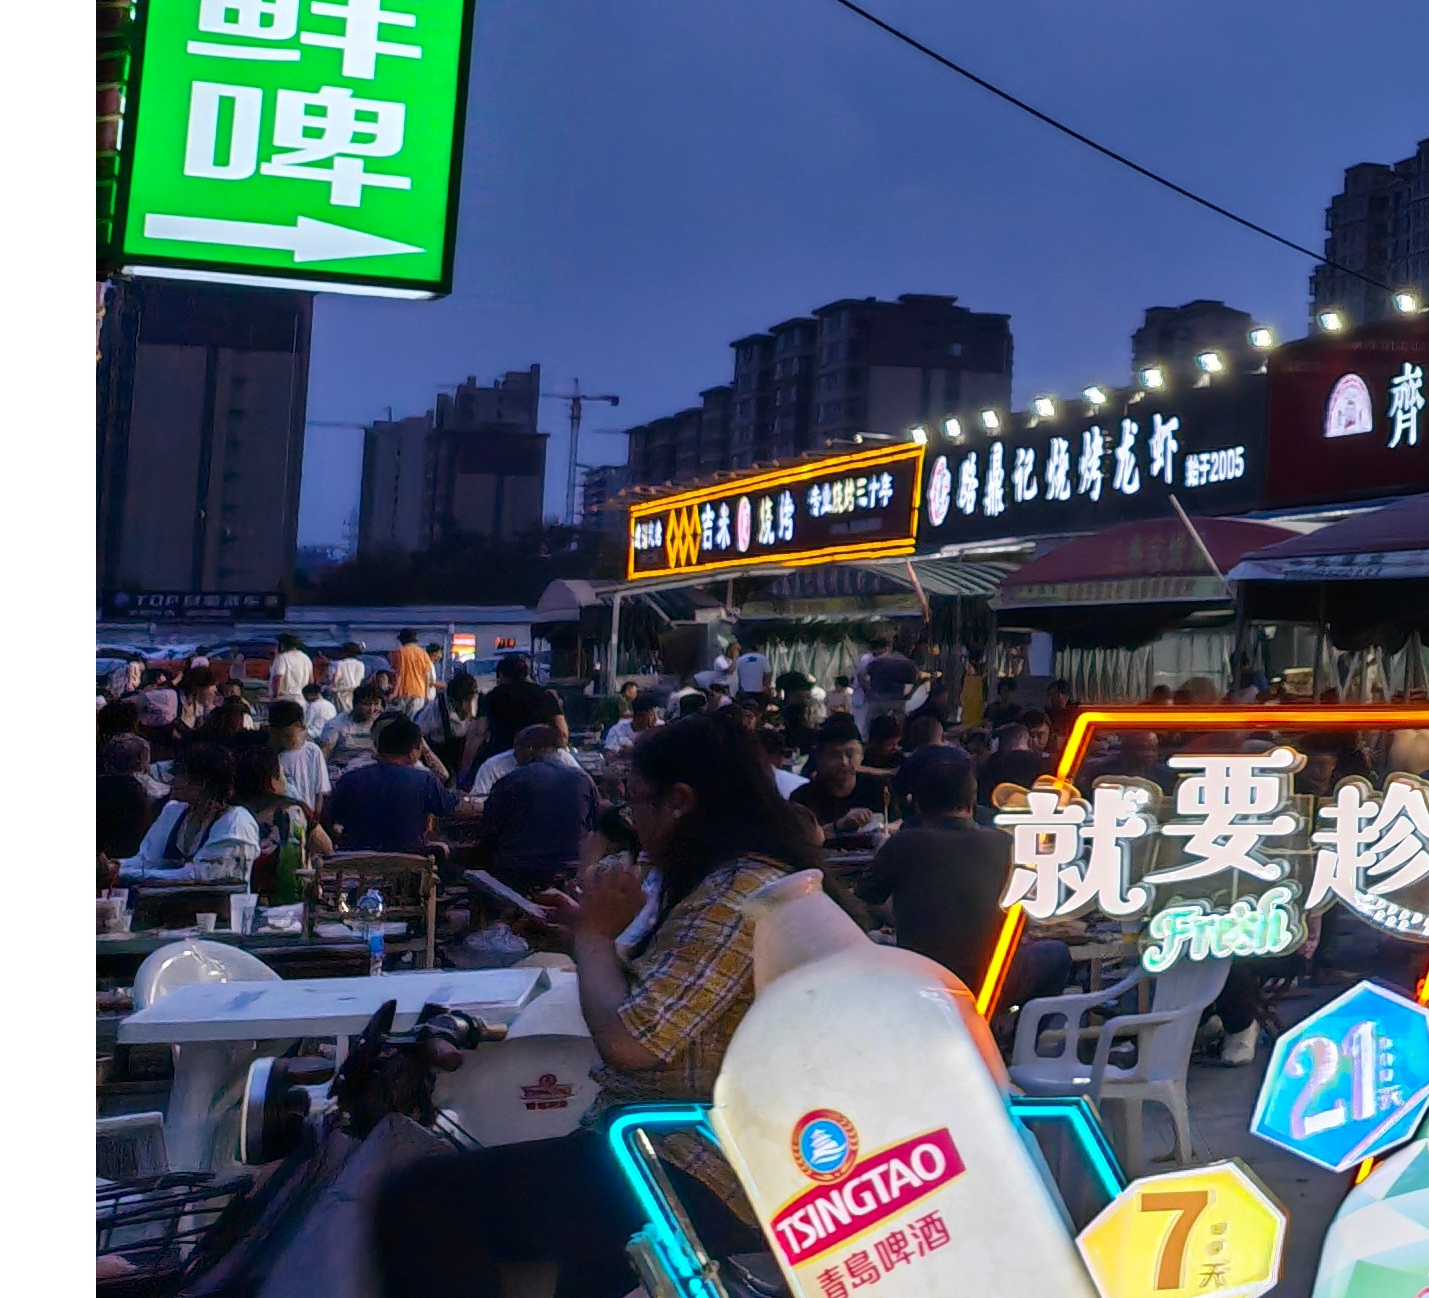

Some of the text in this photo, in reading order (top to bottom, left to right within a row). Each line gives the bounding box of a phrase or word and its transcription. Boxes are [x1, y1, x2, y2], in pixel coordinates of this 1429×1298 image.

[1284, 1020, 1377, 1140] 21
[776, 1141, 948, 1256] TSINGTAO
[1140, 1189, 1211, 1292] 7
